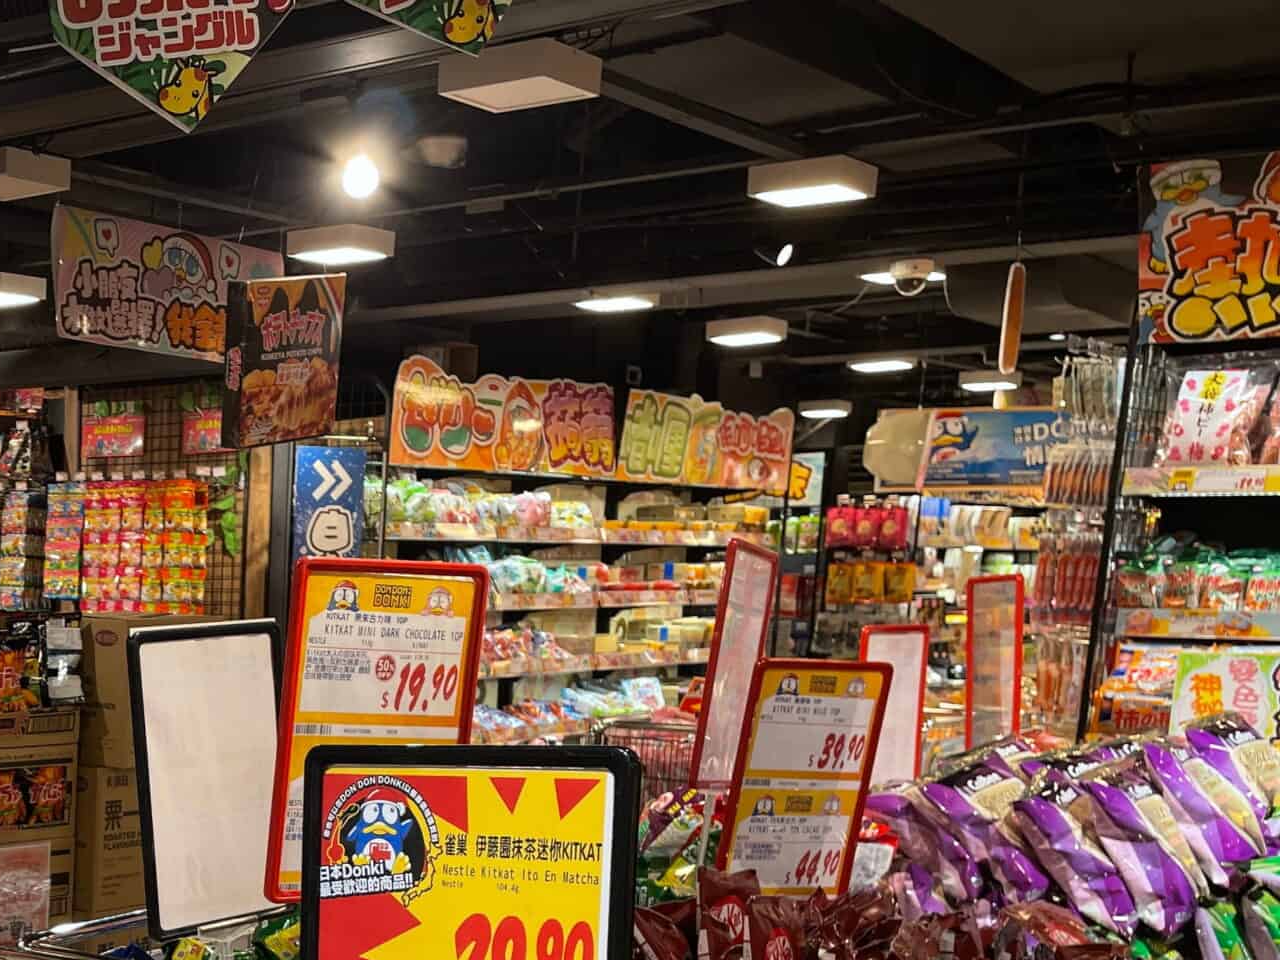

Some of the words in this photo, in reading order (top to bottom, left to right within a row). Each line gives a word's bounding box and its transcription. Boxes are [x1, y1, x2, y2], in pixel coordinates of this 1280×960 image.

[96, 12, 258, 63] ジャングル
[324, 624, 353, 636] KITKAT
[380, 628, 400, 639] DARK
[405, 629, 446, 641] CHOCOLATE
[444, 835, 468, 857] 雀巢
[476, 836, 603, 863] 伊藤園抹茶迷你KITKAT
[320, 861, 384, 881] 日本Donki
[442, 864, 476, 877] Nestle
[481, 867, 516, 881] Kitkat
[522, 869, 539, 882] Ito
[544, 871, 557, 883] En
[563, 872, 600, 887] Matcha
